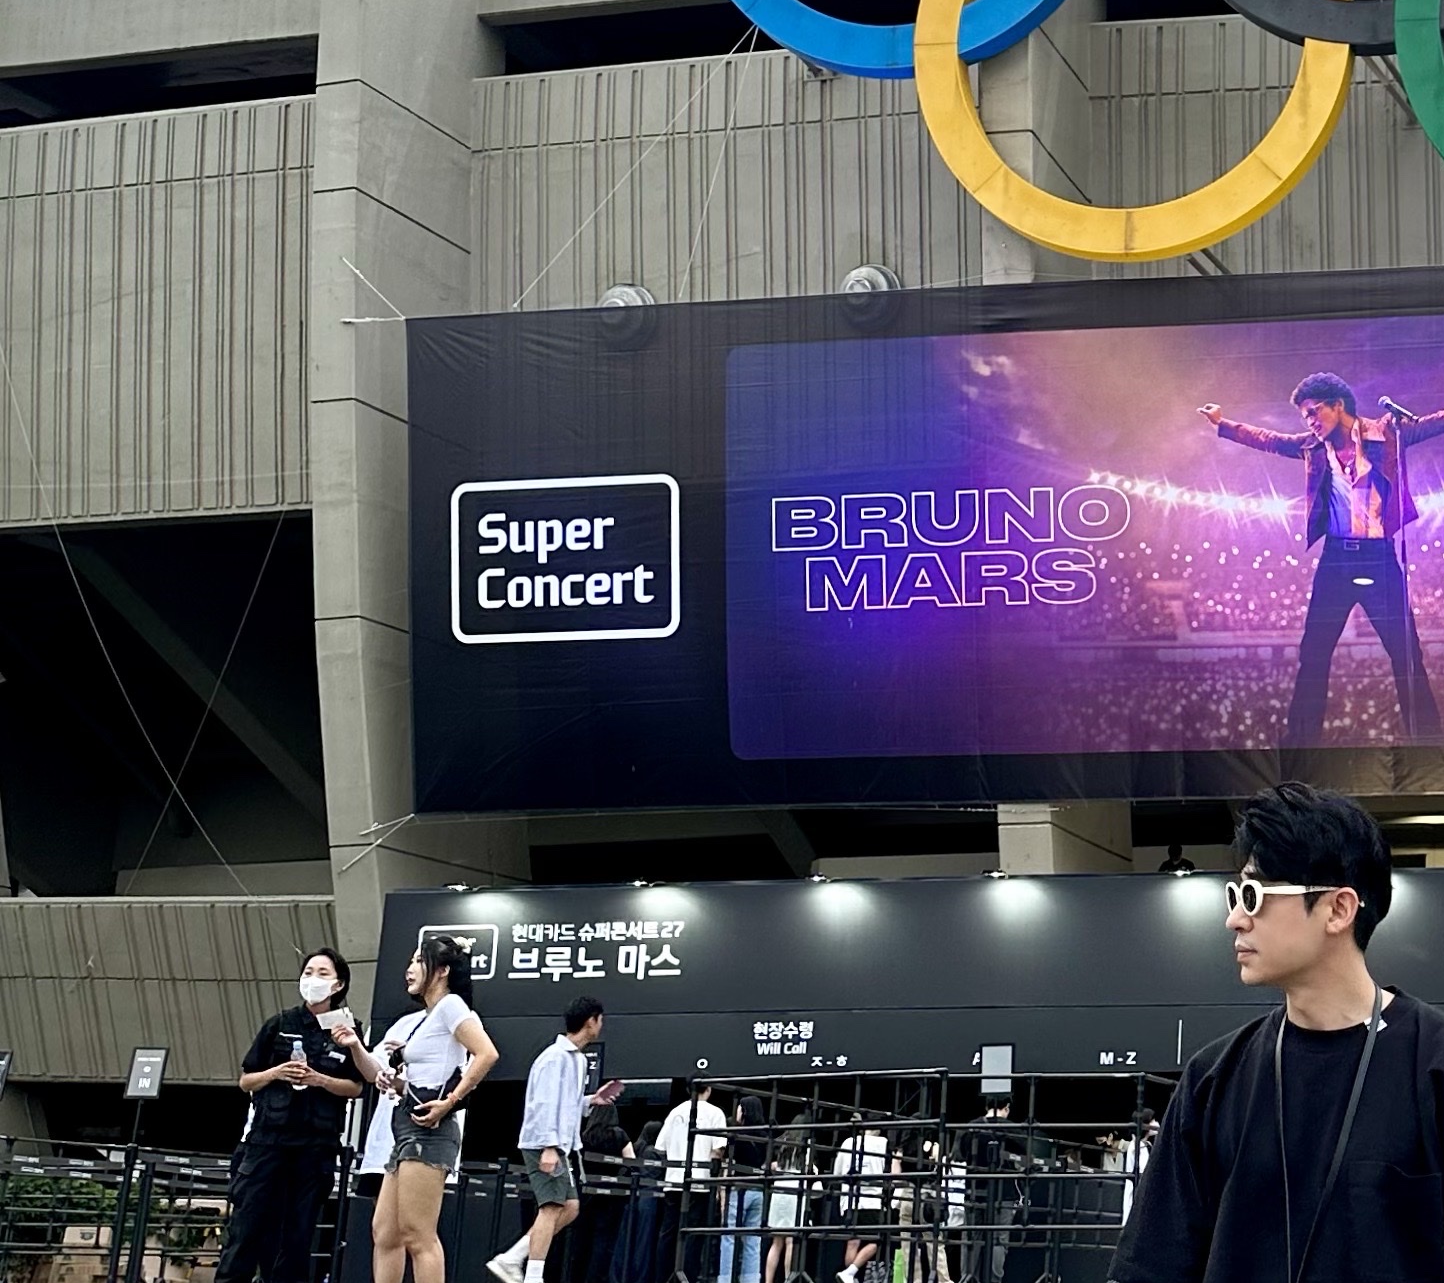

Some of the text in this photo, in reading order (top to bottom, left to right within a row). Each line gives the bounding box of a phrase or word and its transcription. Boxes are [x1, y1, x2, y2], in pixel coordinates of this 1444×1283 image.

[477, 512, 615, 564] Super
[771, 484, 1132, 552] BRUNO
[477, 564, 655, 609] Concert
[805, 547, 1097, 612] MARS
[511, 920, 686, 943] 현대카드 슈퍼콘서트 27
[507, 946, 606, 982] 브루노
[616, 943, 682, 980] 마스
[753, 1020, 815, 1041] 현장수령
[756, 1041, 808, 1055] Will Call
